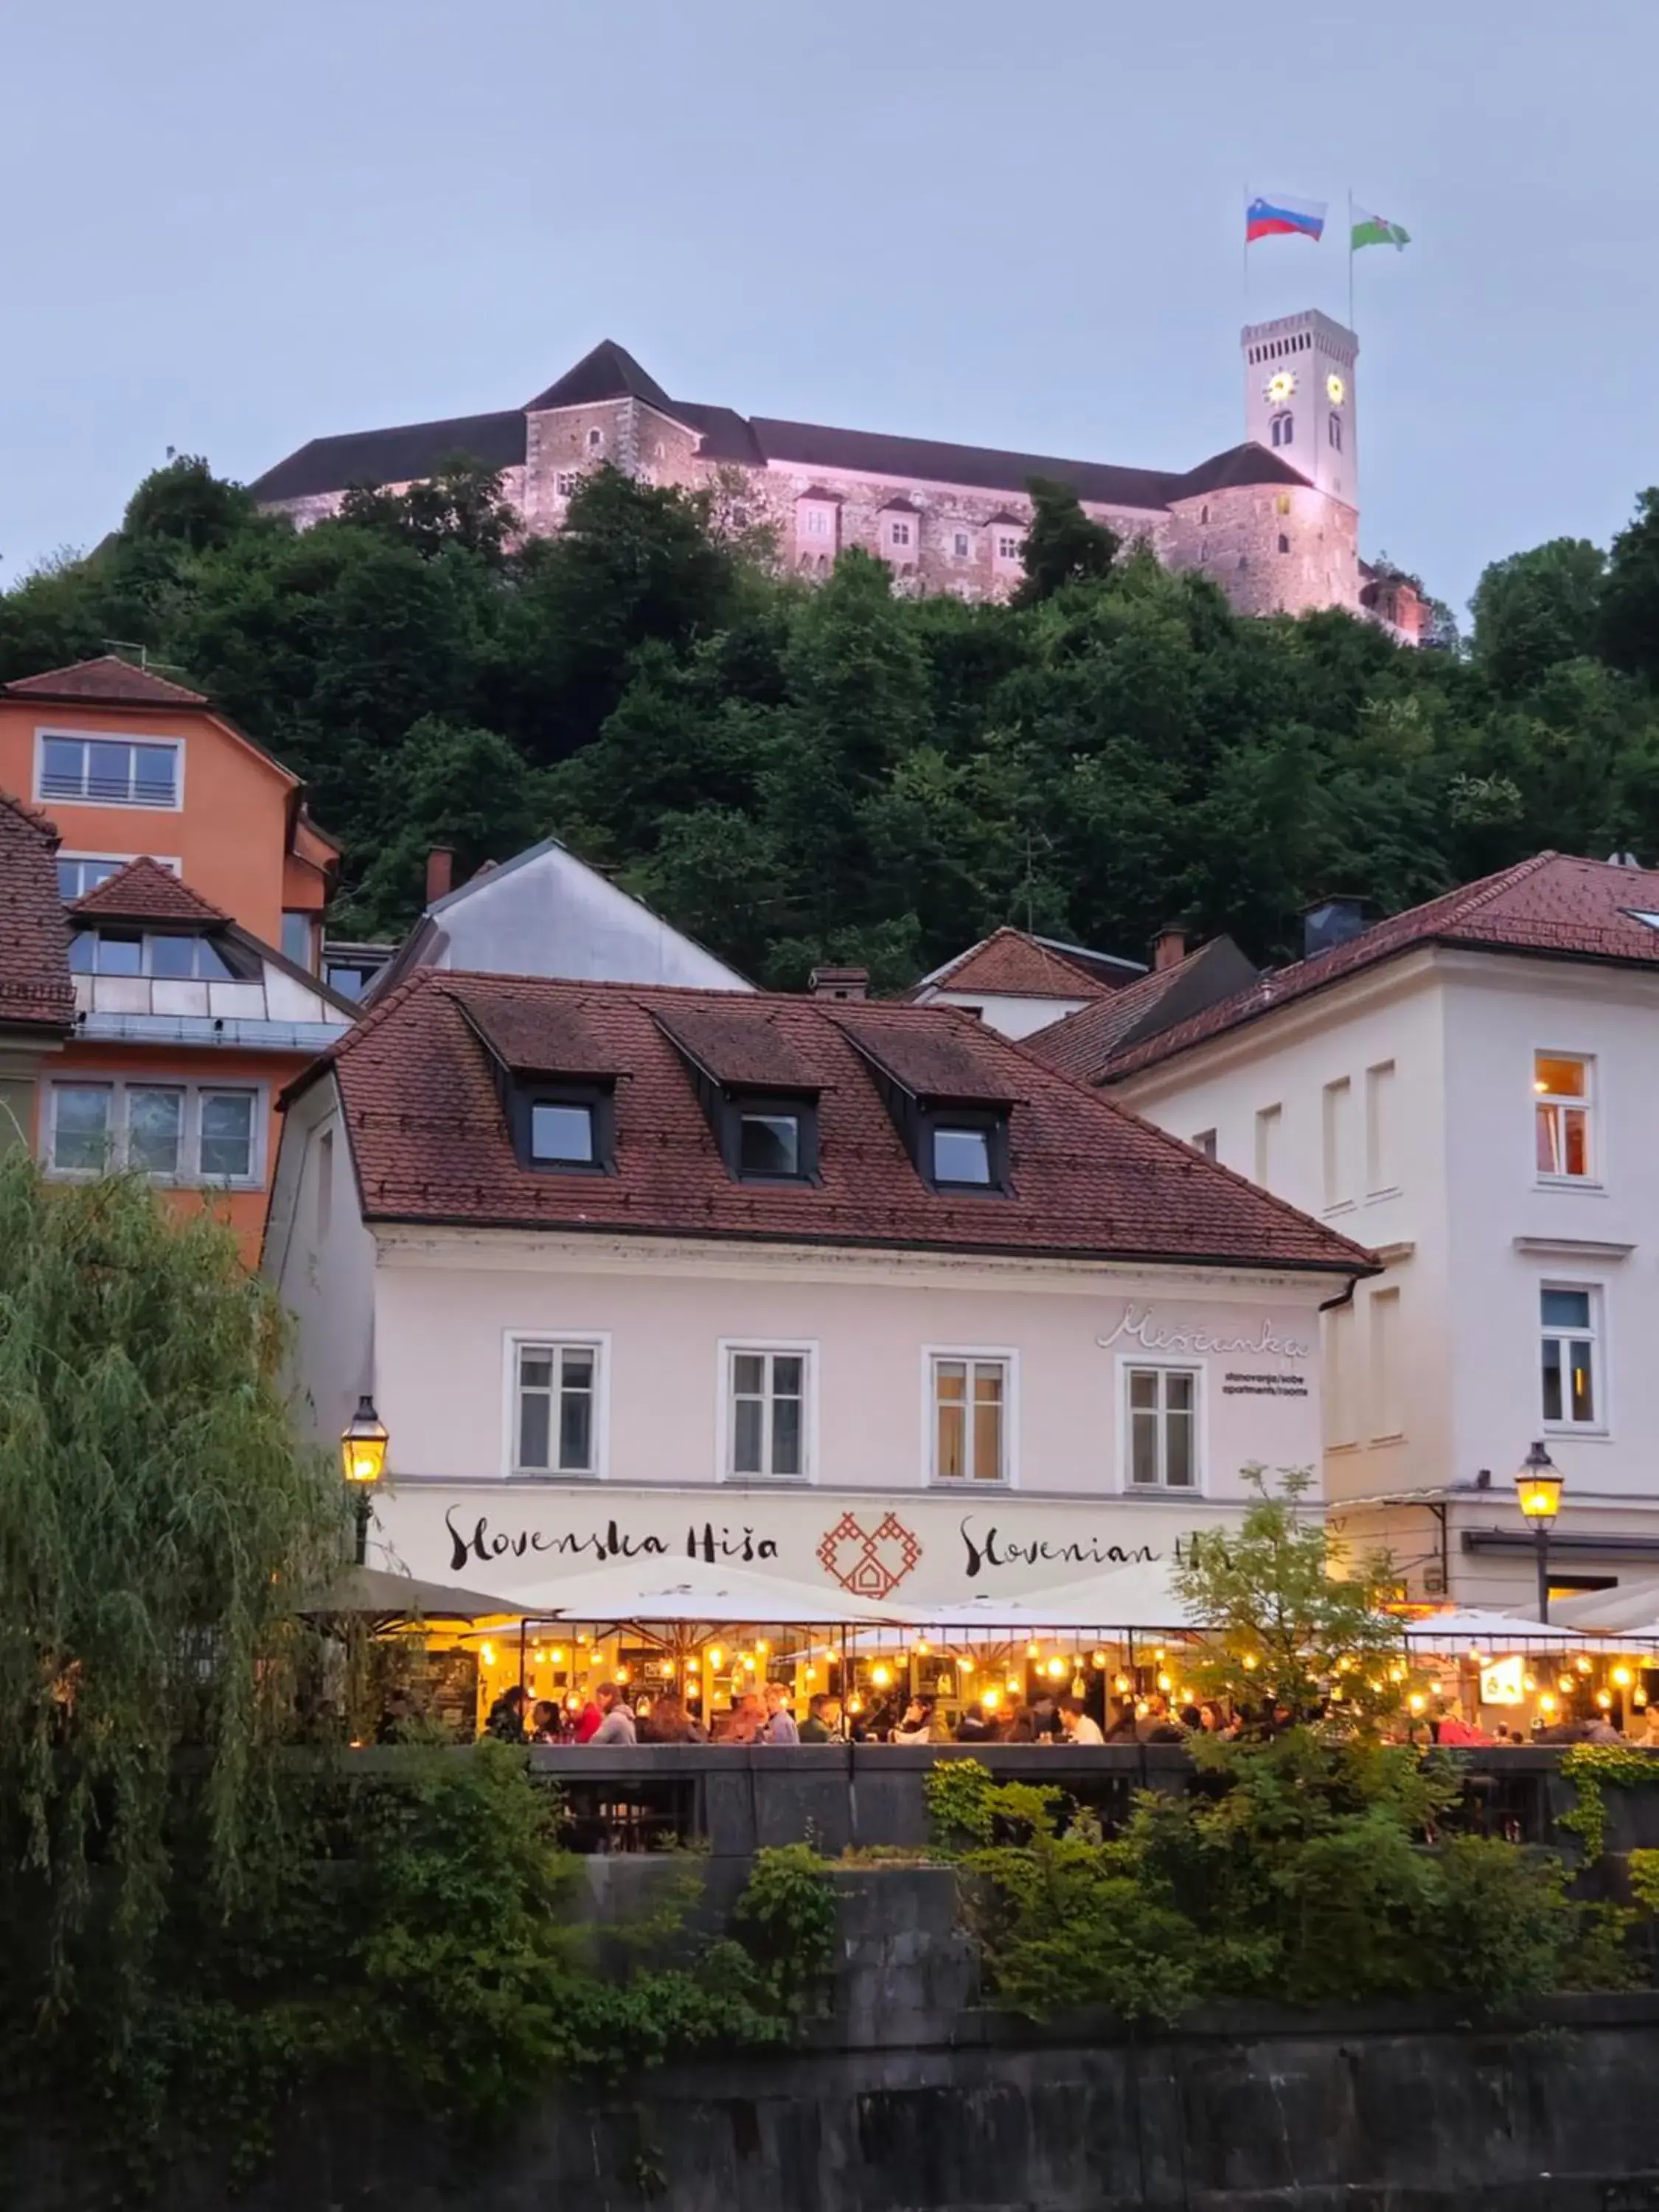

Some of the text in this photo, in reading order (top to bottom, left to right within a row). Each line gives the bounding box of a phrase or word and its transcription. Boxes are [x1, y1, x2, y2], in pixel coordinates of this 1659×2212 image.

[1222, 1385, 1309, 1397] apartments/rooms
[445, 1503, 779, 1571] Slovenska Hiša
[960, 1515, 1162, 1577] Slovenian
